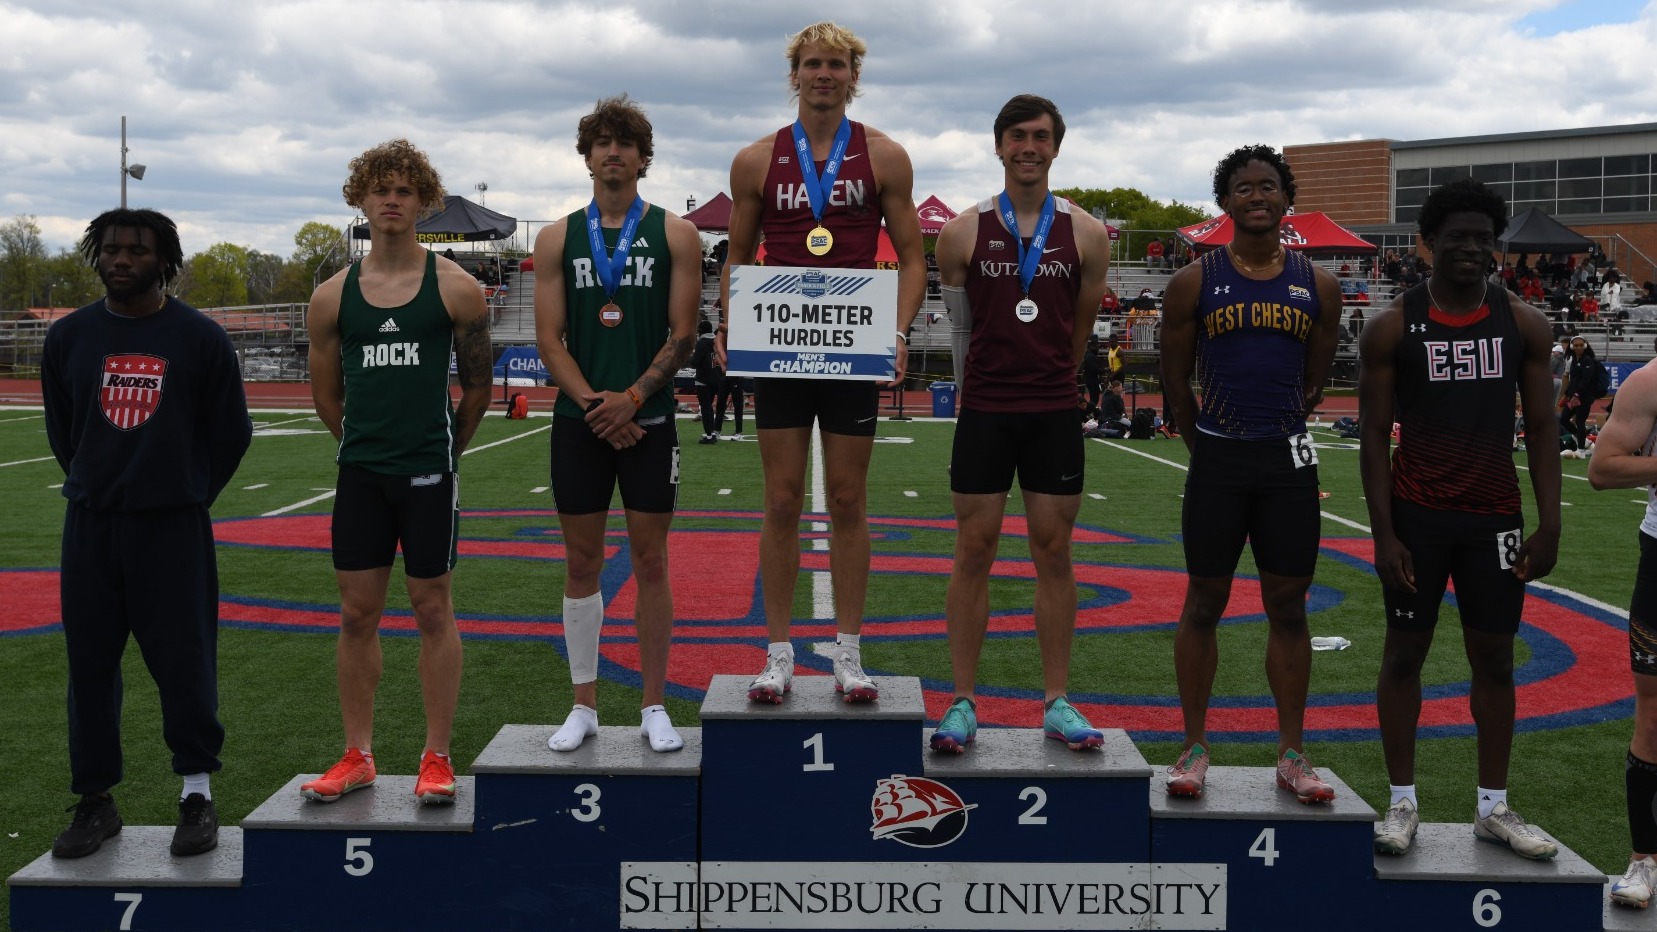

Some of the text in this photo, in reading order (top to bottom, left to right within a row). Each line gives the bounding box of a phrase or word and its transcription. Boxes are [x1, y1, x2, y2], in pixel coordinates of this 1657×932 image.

[776, 179, 864, 211] HAEN
[573, 256, 655, 289] RCK
[980, 260, 1072, 279] KUTZOWN
[753, 303, 873, 325] 110-METER
[1203, 302, 1245, 339] WEST
[769, 328, 854, 347] HURDLES
[362, 342, 420, 368] ROCK
[769, 360, 852, 374] CHAMPION
[797, 353, 825, 361] MEN'S
[1423, 337, 1504, 381] ESU
[107, 374, 159, 389] RAIDERS
[1296, 433, 1312, 465] 6
[1504, 533, 1518, 566] 8
[803, 732, 835, 772] 1
[571, 783, 602, 822] 3
[1018, 786, 1048, 825] 2
[343, 838, 374, 876] 5
[1248, 828, 1280, 867] 4
[114, 892, 143, 931] 7
[625, 876, 1220, 915] SHIPPENSBURG UNIVERSITY
[1472, 888, 1502, 928] 6
